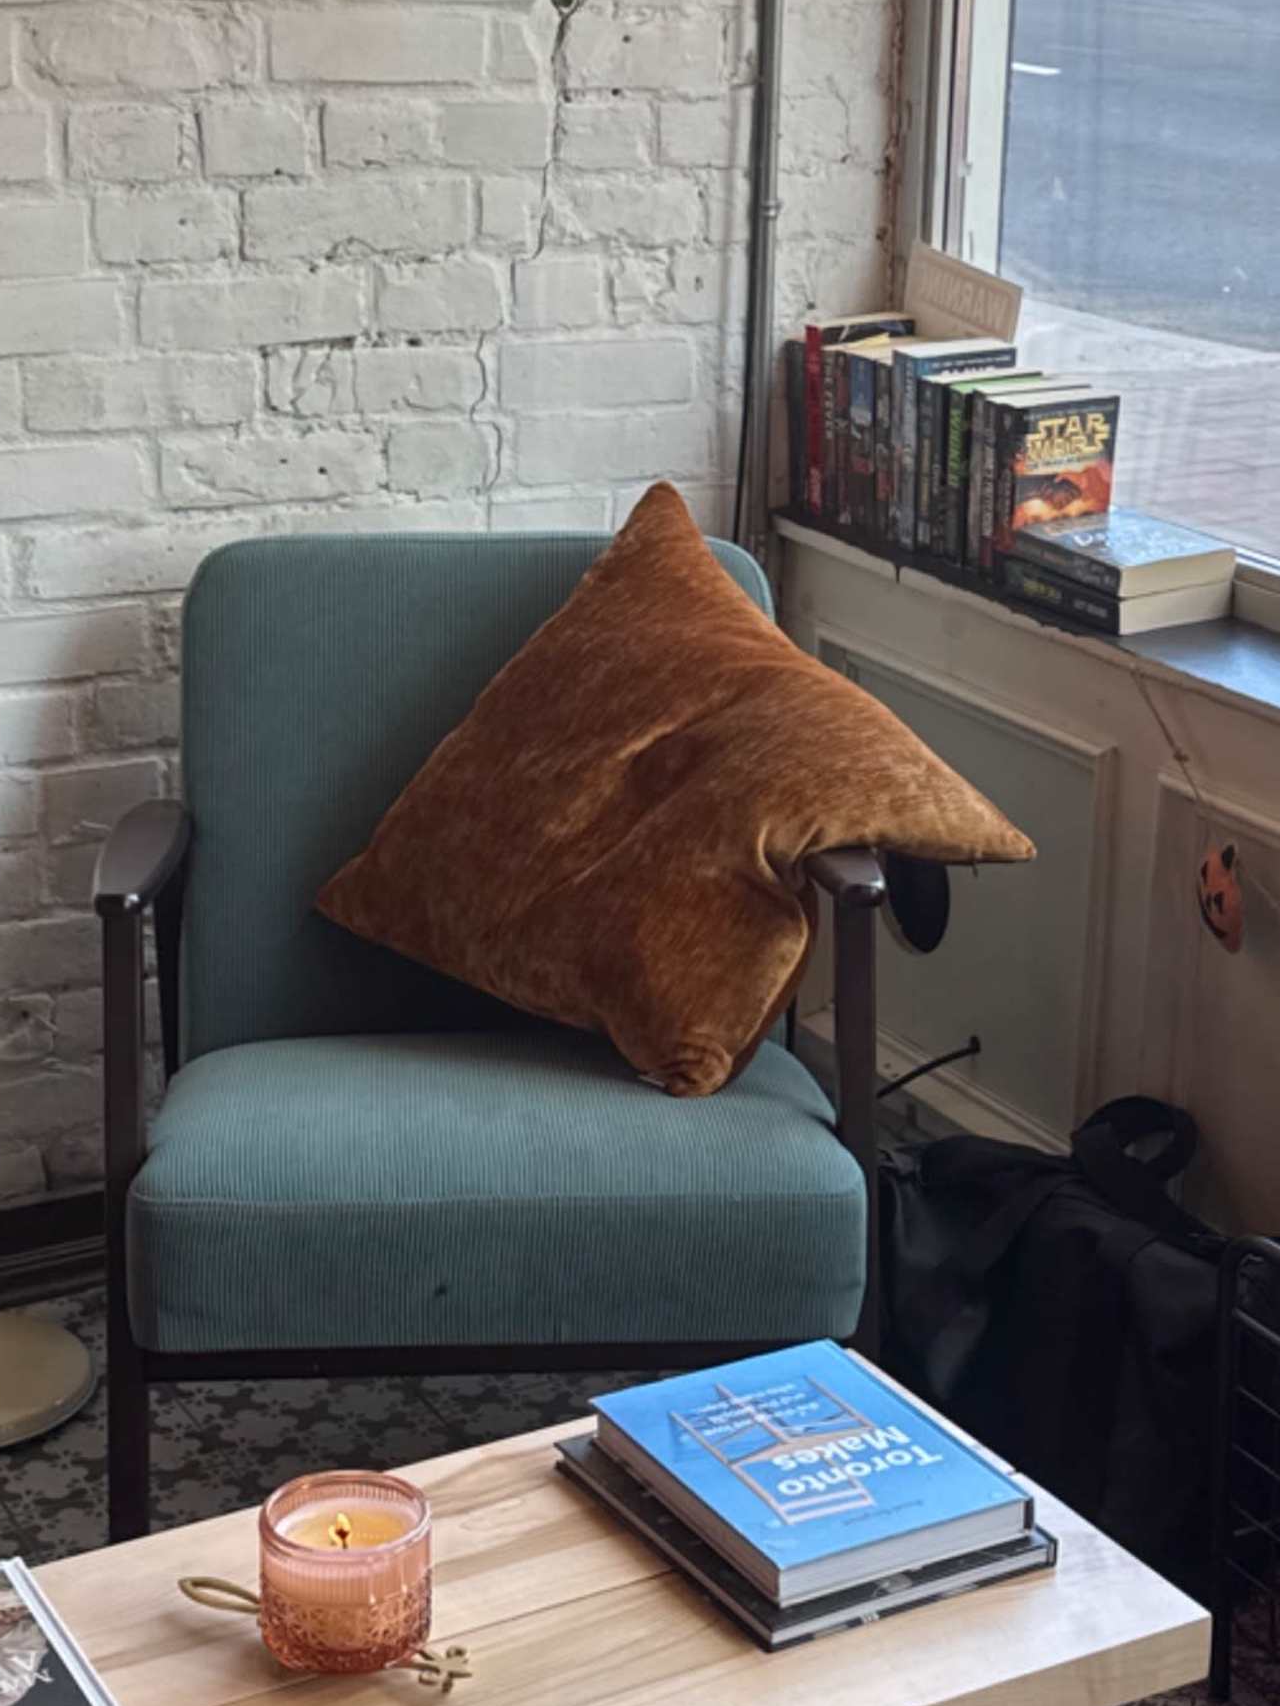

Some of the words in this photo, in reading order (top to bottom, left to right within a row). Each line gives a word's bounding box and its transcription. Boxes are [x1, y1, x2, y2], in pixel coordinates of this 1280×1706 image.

[1026, 413, 1110, 442] STAR
[1026, 432, 1109, 462] WARS
[774, 1423, 911, 1472] Makes
[778, 1444, 943, 1497] Toronto
[10, 1651, 41, 1673] A
